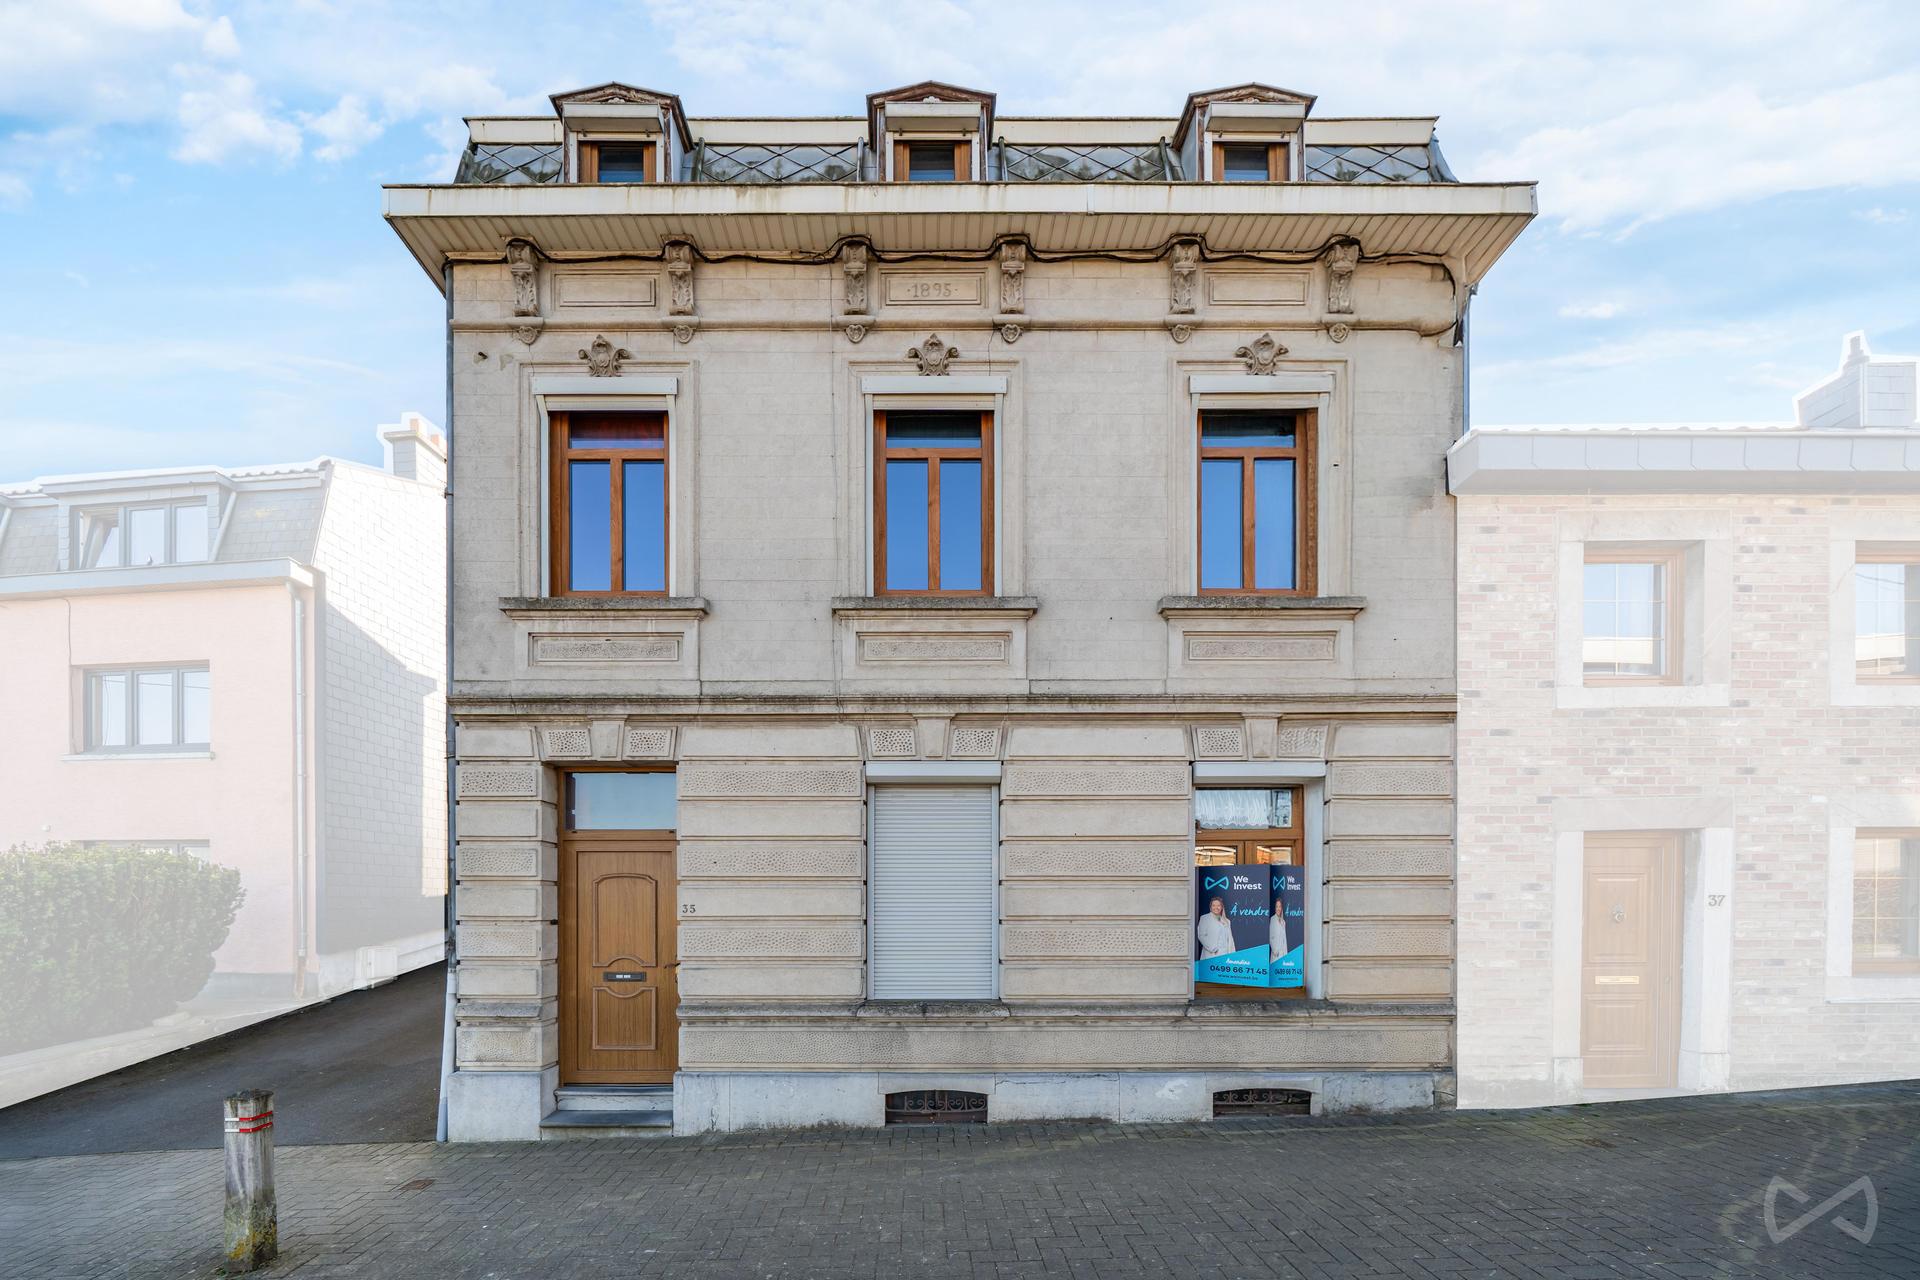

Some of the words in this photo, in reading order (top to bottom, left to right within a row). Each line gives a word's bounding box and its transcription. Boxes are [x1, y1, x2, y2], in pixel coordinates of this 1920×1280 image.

[1233, 875, 1249, 883] We
[1286, 875, 1296, 883] We
[1708, 894, 1726, 907] 37
[682, 904, 696, 914] 35
[1240, 905, 1270, 917] vendre
[1210, 965, 1231, 973] 0499
[1232, 966, 1244, 974] 66
[1256, 968, 1268, 976] 45
